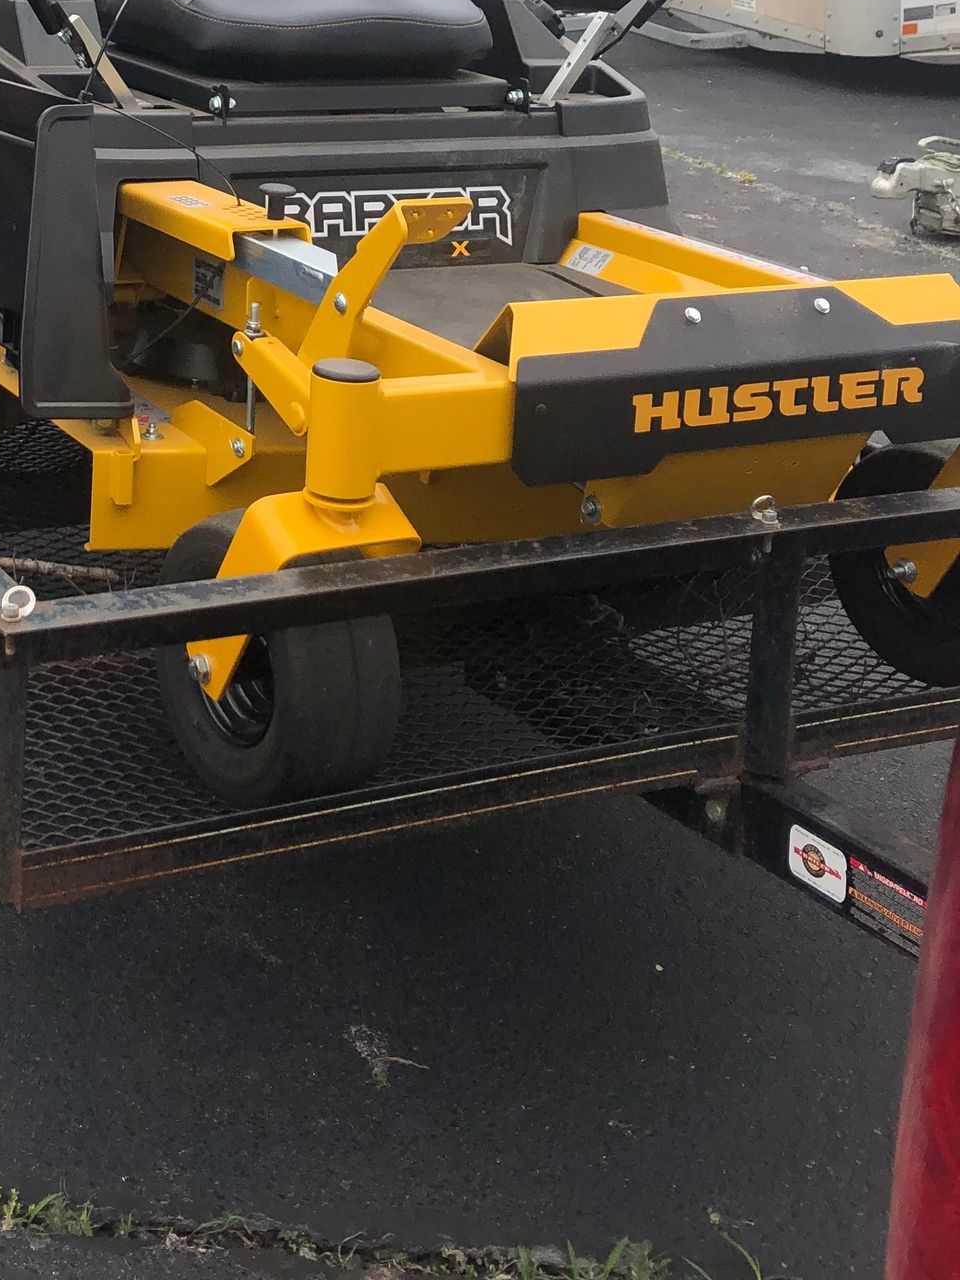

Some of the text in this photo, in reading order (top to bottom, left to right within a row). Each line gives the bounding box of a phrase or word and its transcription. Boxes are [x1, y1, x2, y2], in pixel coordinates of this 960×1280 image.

[265, 185, 513, 246] RAPR
[451, 240, 470, 257] X
[632, 366, 925, 433] HUSTLER
